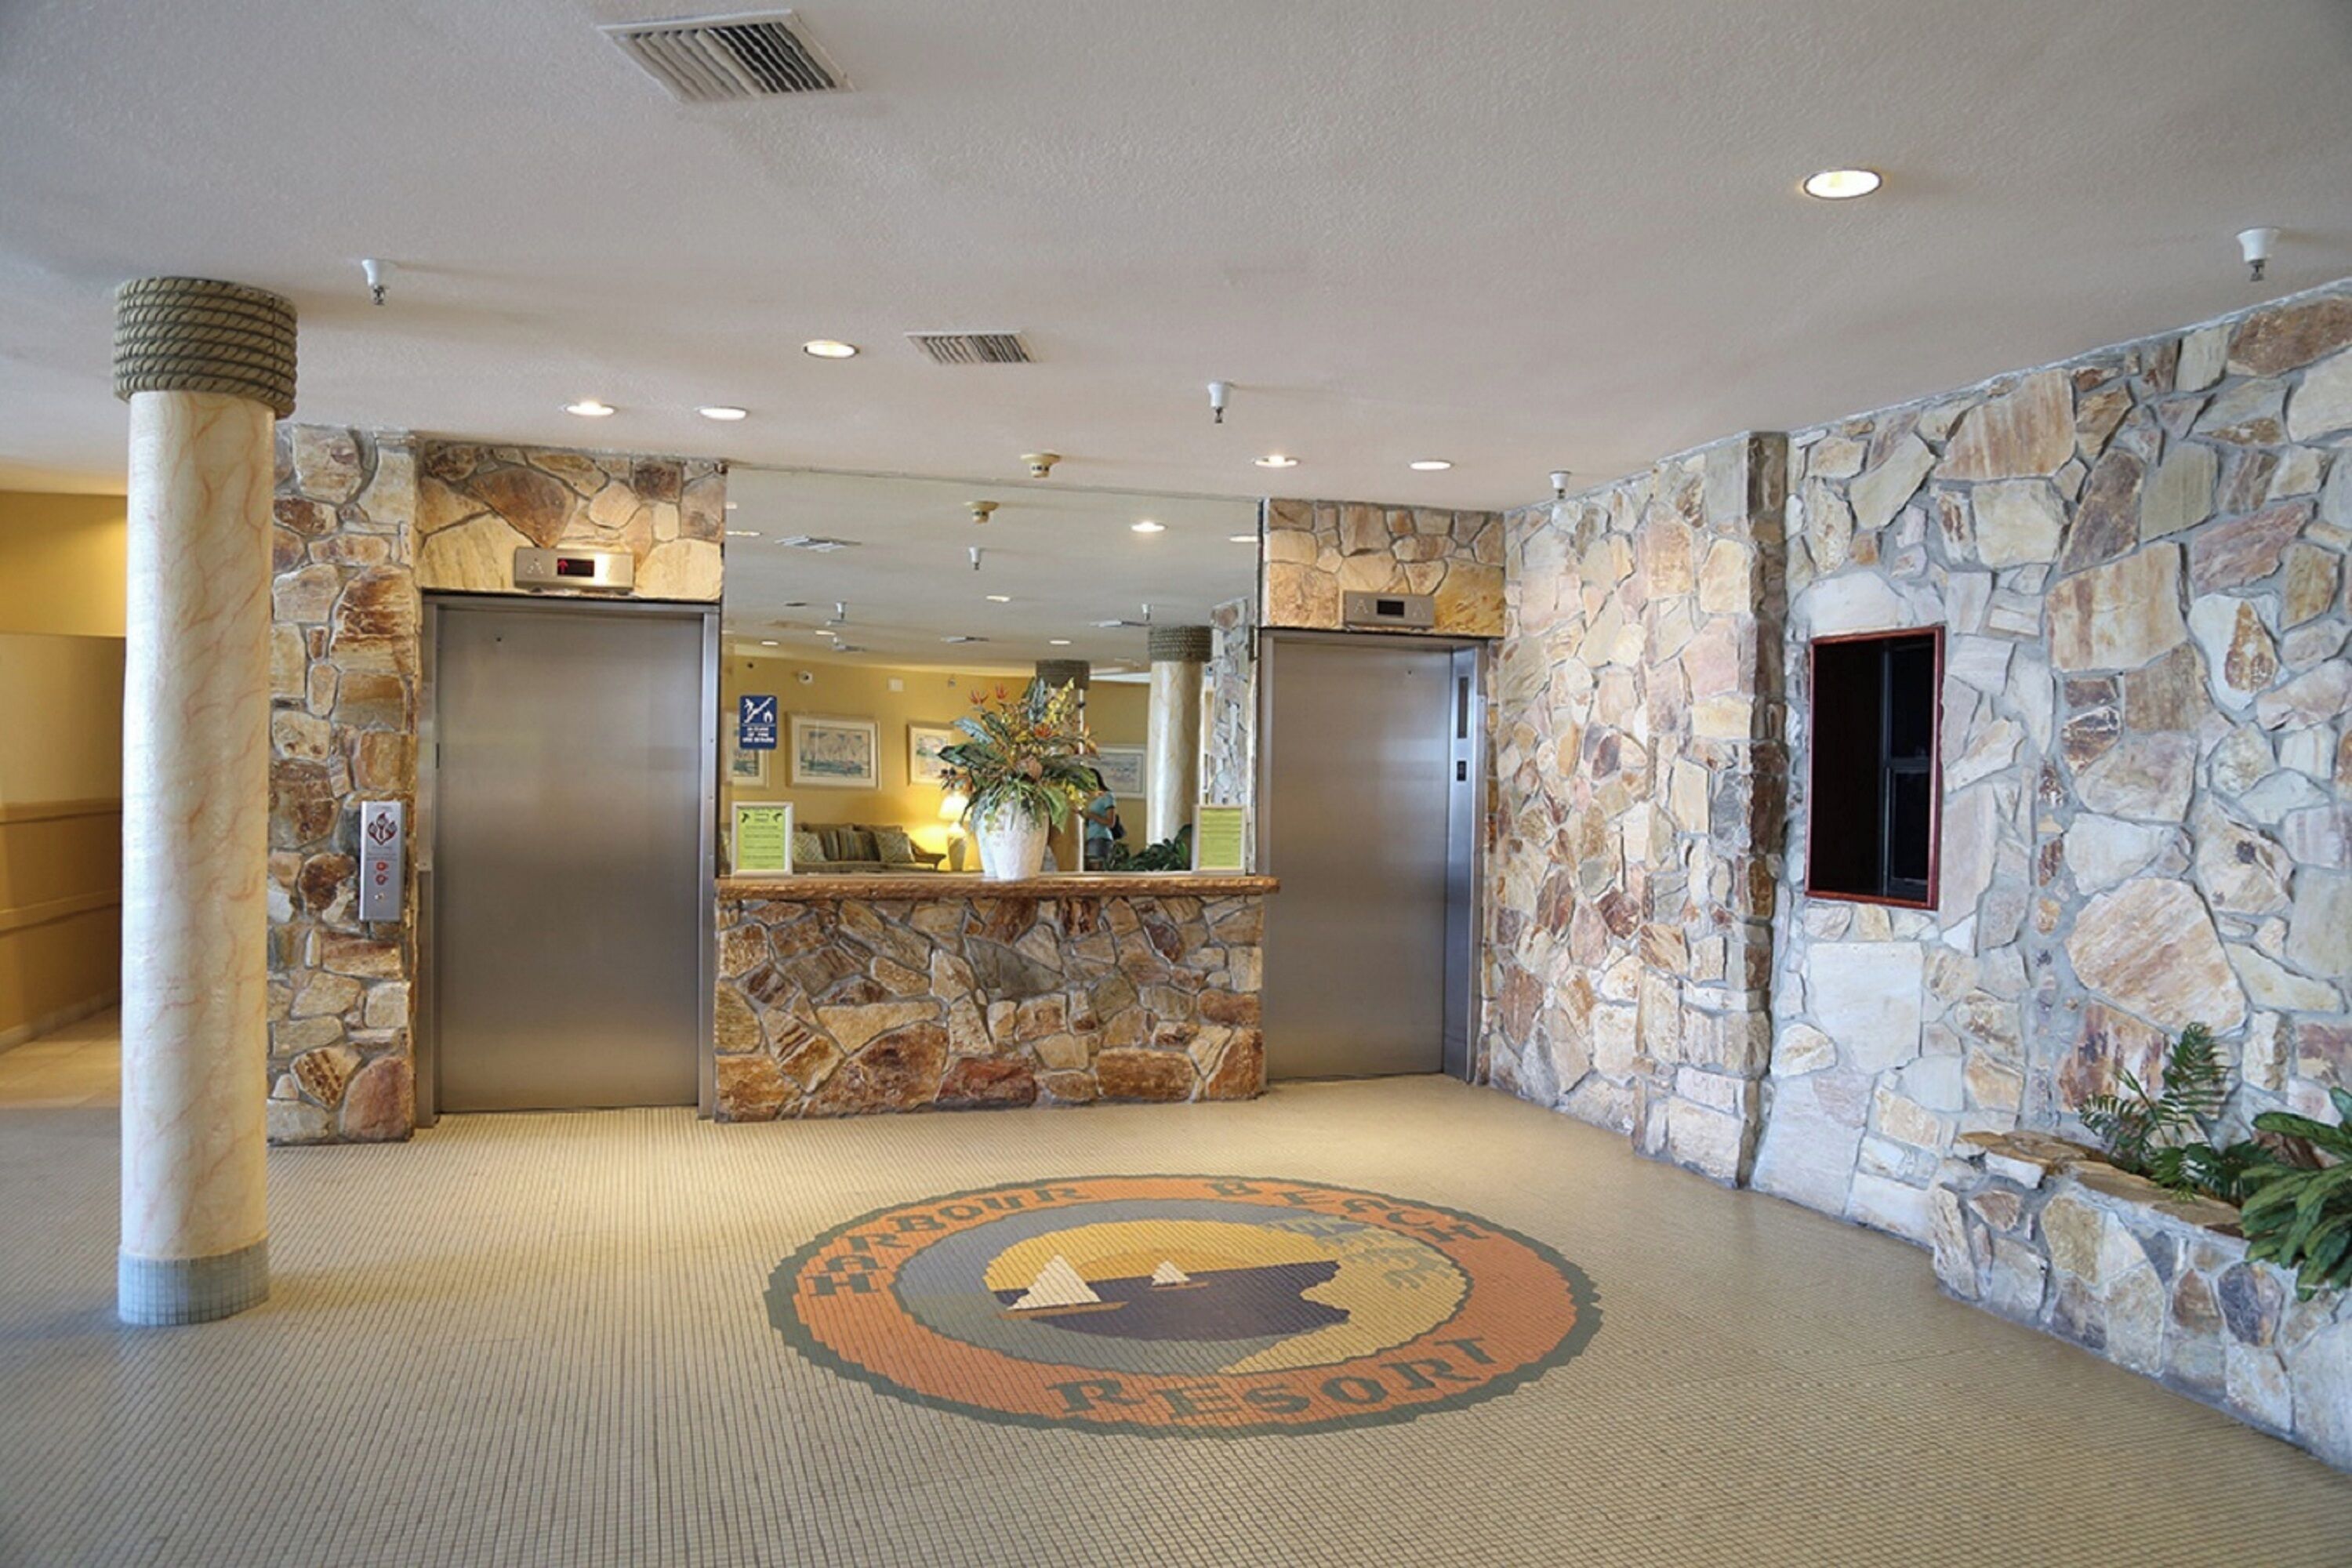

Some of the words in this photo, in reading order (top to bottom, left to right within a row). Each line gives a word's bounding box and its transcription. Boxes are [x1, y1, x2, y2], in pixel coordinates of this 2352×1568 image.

[804, 1188, 1091, 1296] HARBOUR
[1206, 1179, 1490, 1242] BEACH
[1046, 1337, 1497, 1419] RESORT
